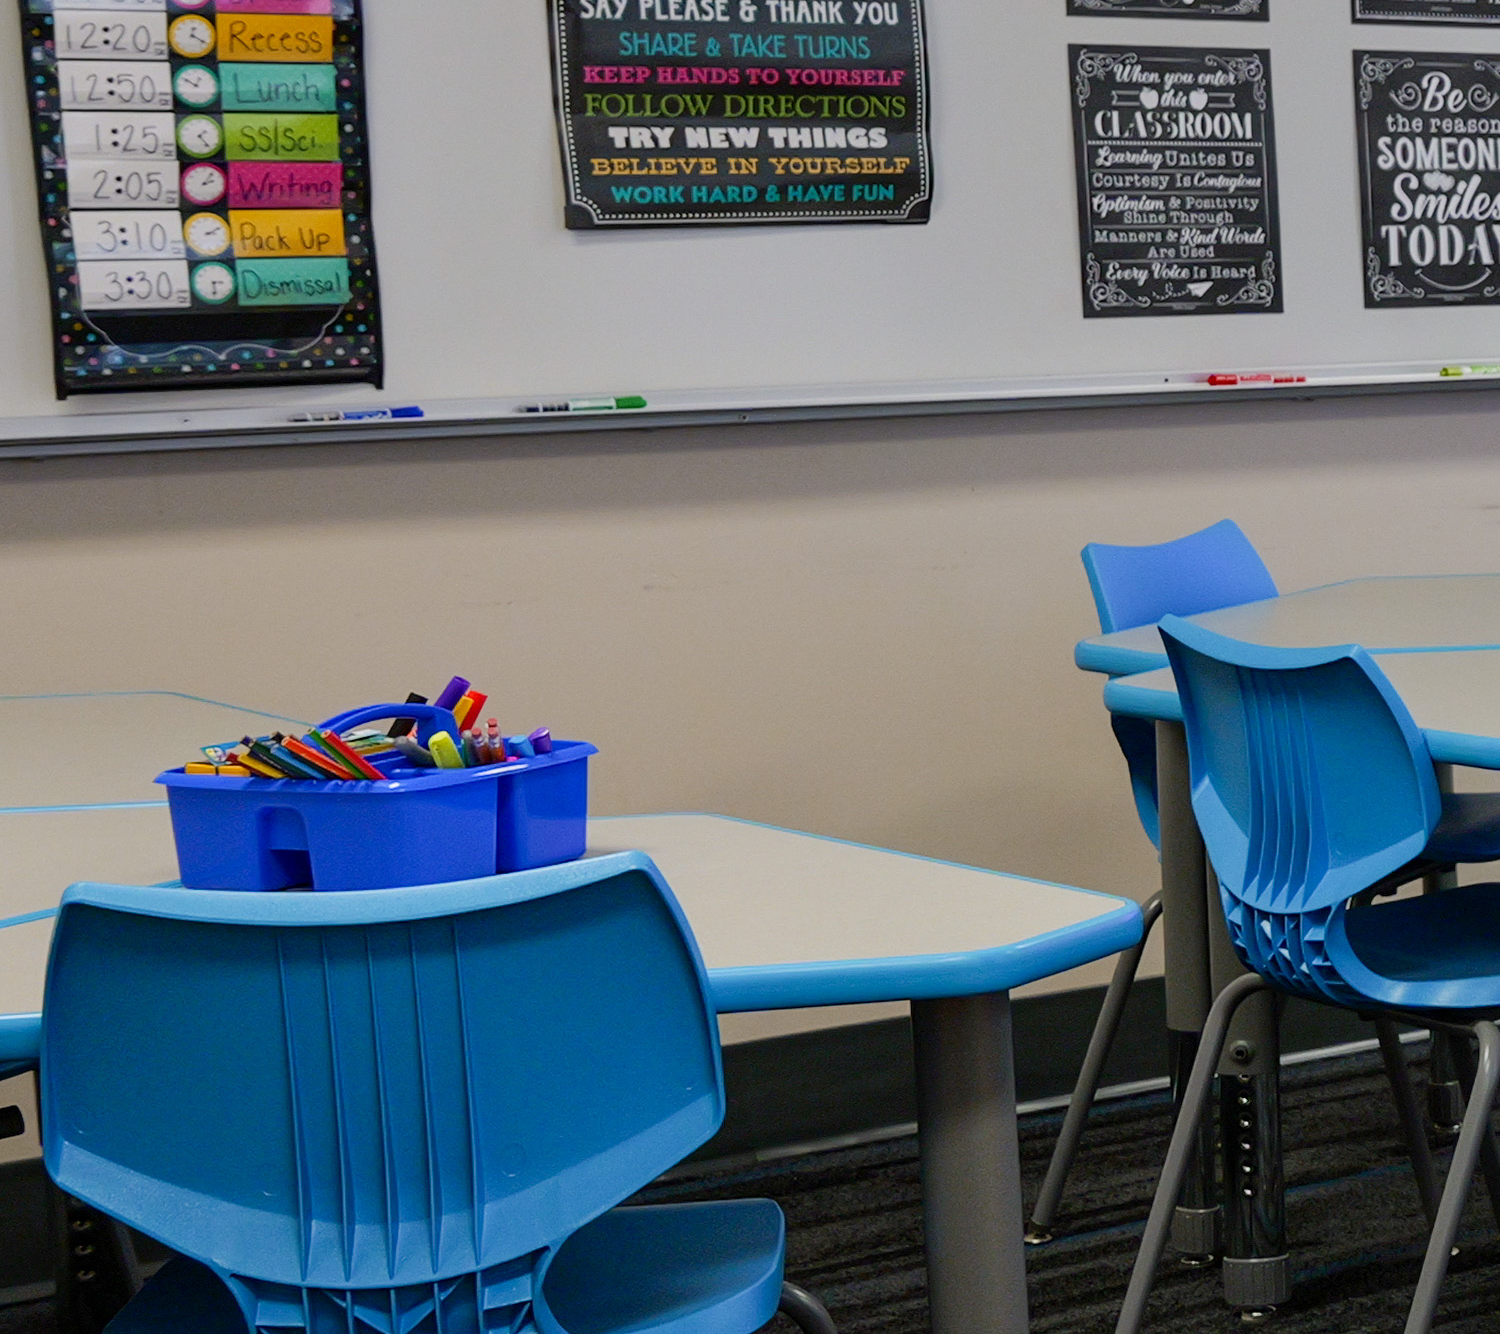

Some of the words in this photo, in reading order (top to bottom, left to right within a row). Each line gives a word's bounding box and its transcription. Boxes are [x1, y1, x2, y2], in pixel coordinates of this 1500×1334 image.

[766, 0, 846, 24] THANK
[853, 2, 899, 25] YOU
[65, 22, 151, 52] 12:20
[229, 20, 322, 53] Recess
[618, 32, 698, 57] SHARE
[706, 37, 721, 57] &
[729, 34, 786, 58] TAKE
[794, 34, 871, 59] TURNS
[69, 73, 156, 103] 12:50
[235, 73, 320, 104] Lunch
[582, 65, 651, 84] KEEP
[656, 67, 740, 84] HANDS
[746, 68, 779, 85] TO
[785, 69, 907, 86] YOURSELF
[1114, 64, 1161, 84] When
[1165, 70, 1194, 90] you
[1198, 72, 1237, 86] enter
[584, 94, 714, 118] FOLLOW
[724, 94, 907, 118] DIRECTIONS
[1160, 91, 1187, 107] this
[1421, 71, 1467, 113] Be
[608, 126, 674, 149] TRY
[684, 127, 760, 149] NEW
[768, 127, 888, 149] THINGS
[1094, 110, 1253, 139] CLASSROOM
[1386, 114, 1423, 133] the
[95, 125, 159, 154] 1:25
[591, 157, 717, 176] BELIEVE
[727, 158, 759, 175] IN
[770, 158, 910, 175] YOURSELF
[1095, 147, 1165, 170] Learning
[1165, 151, 1226, 166] Unites
[1232, 151, 1255, 166] Us
[93, 170, 162, 200] 2:05
[237, 174, 332, 206] Writing
[612, 186, 684, 203] WORK
[692, 186, 758, 203] HARD
[765, 187, 780, 202] &
[787, 184, 845, 203] HAVE
[852, 184, 894, 202] FUN
[1092, 172, 1169, 189] Courtesy
[1194, 172, 1262, 193] Contagious
[97, 221, 166, 251] 3:10
[240, 222, 289, 251] Pack
[303, 221, 330, 249] Up
[104, 271, 172, 300] 3:30
[242, 268, 341, 300] Dismissal
